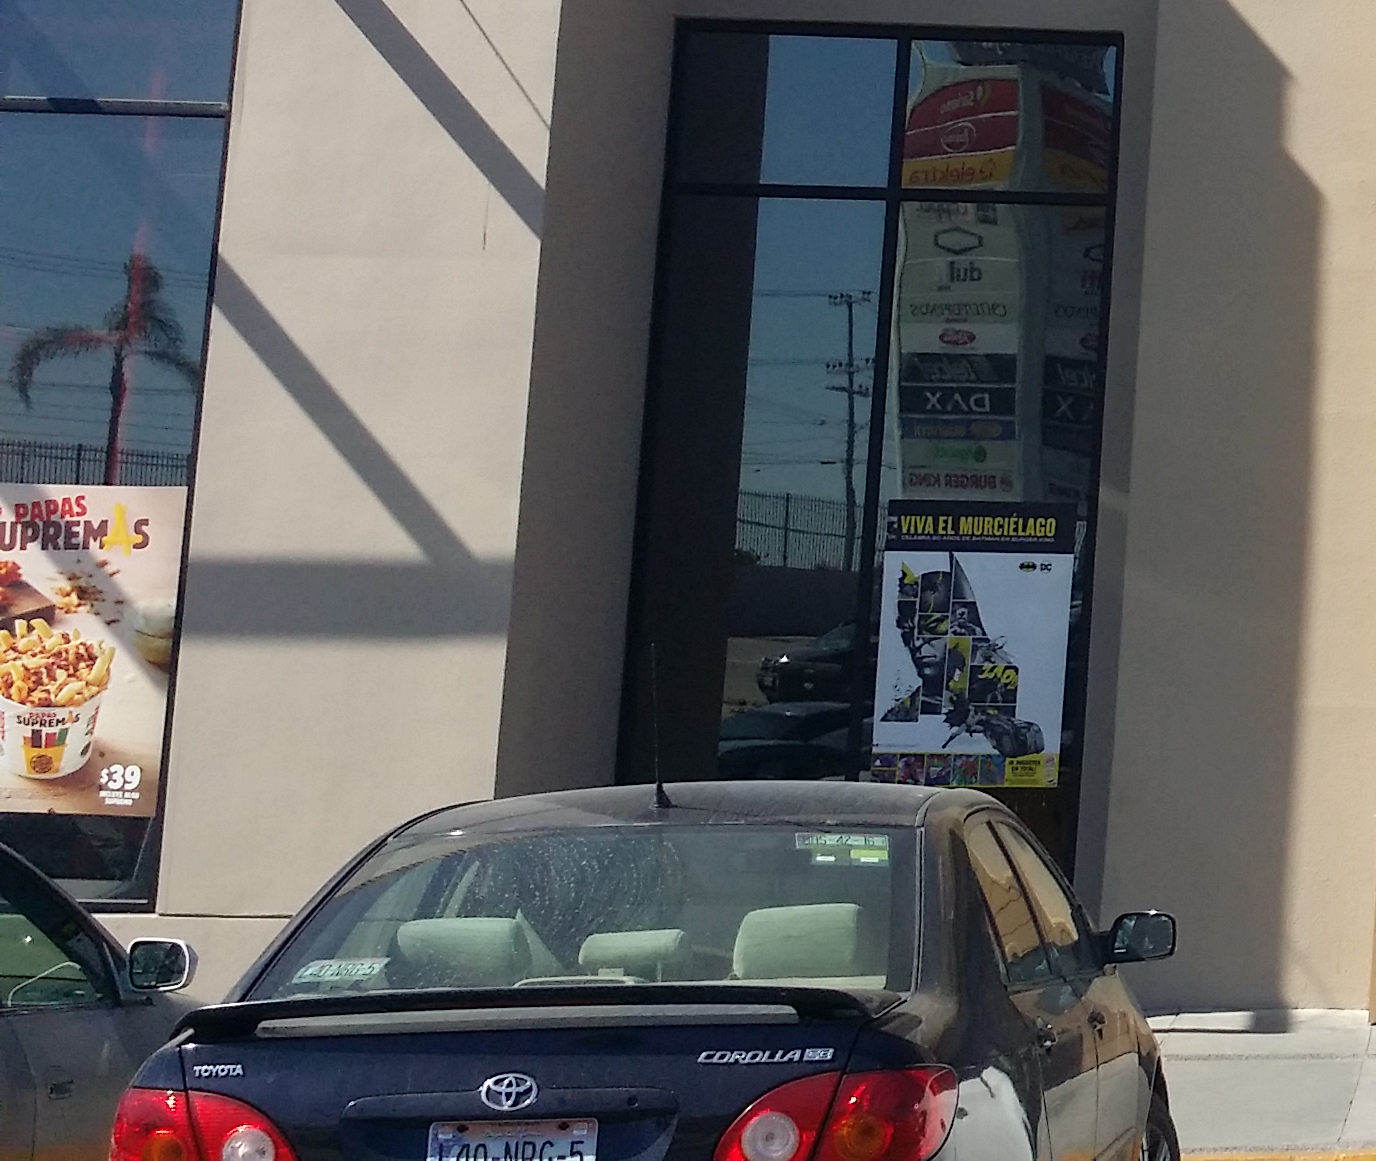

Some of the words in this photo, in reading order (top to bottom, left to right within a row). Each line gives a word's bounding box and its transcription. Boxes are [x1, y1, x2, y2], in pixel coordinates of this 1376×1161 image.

[15, 495, 88, 524] PAPAS
[0, 503, 150, 556] UPREMAS
[901, 515, 934, 535] VIVA
[938, 515, 956, 535] EL
[959, 513, 1057, 537] MURCIÉLAGO
[100, 764, 142, 790] $39
[698, 1049, 802, 1064] COROLLA
[193, 1064, 244, 1078] TOYOTA
